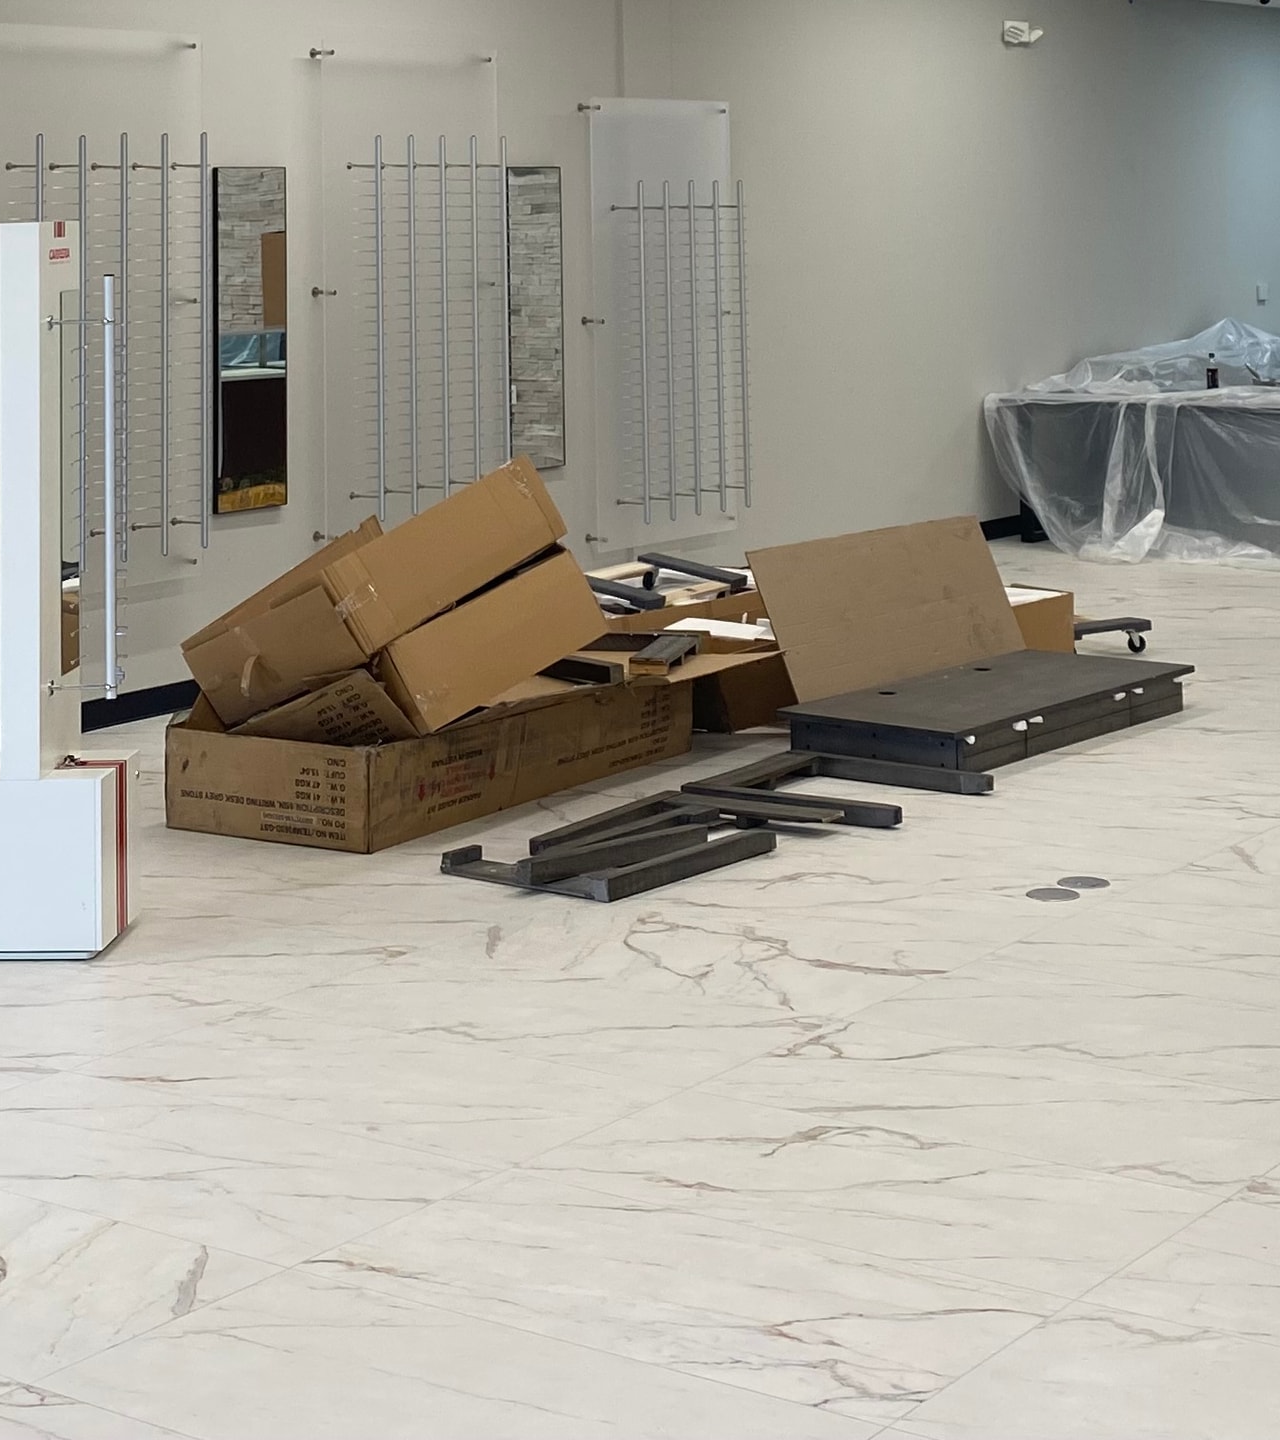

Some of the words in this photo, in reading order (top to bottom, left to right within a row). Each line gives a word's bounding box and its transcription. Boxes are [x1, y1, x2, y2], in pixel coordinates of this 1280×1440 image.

[311, 781, 321, 789] 47
[204, 792, 224, 802] GREY
[224, 794, 245, 805] DESK
[295, 791, 312, 800] KGS
[246, 797, 276, 809] WRITING
[334, 820, 346, 829] PO
[328, 831, 346, 841] ITEM
